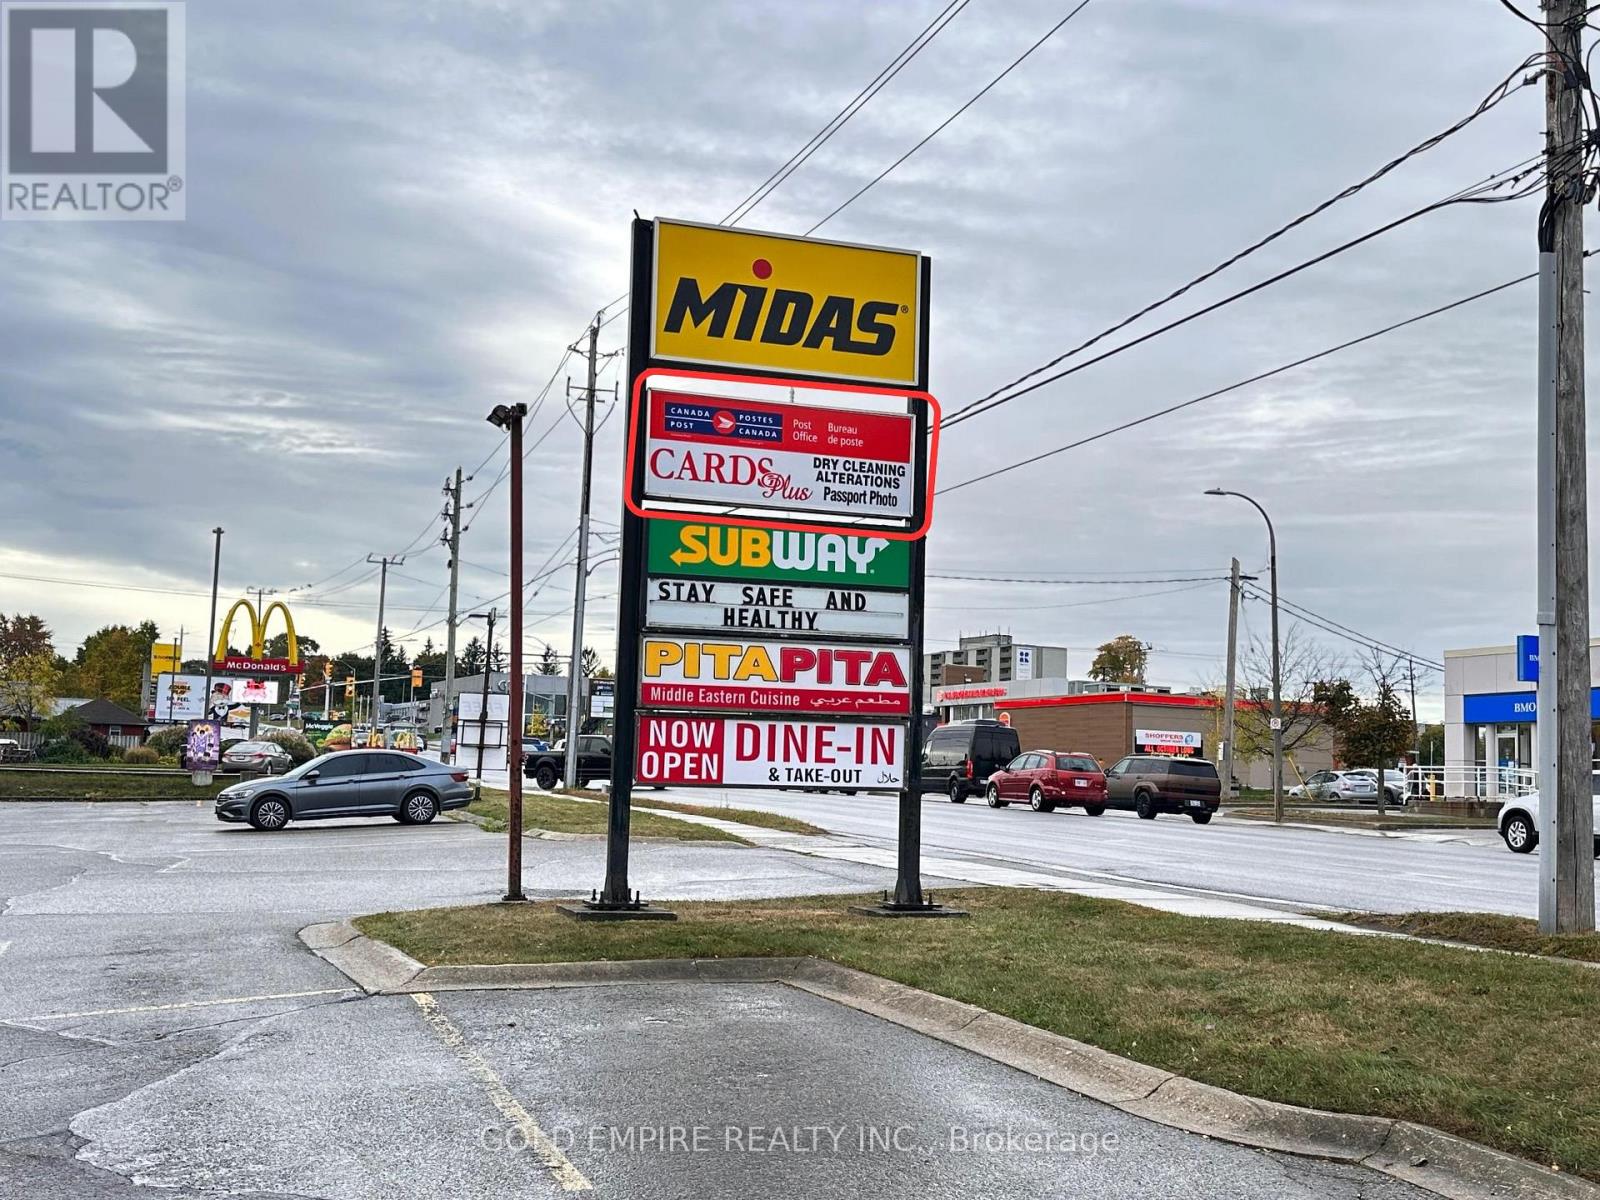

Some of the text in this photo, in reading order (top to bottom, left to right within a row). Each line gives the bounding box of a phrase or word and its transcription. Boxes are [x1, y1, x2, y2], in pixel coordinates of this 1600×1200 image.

[670, 406, 710, 419] CANADA
[739, 414, 774, 425] POSTES
[670, 420, 694, 430] POST
[793, 418, 812, 430] Post
[828, 422, 858, 435] Bureau
[739, 427, 778, 439] CANADA
[792, 430, 818, 443] Office
[827, 435, 864, 448] de poste
[650, 448, 774, 488] CARDS
[813, 456, 906, 478] DRY CLEANING
[761, 472, 813, 501] Plus
[816, 471, 900, 489] ALTERATIONS
[823, 487, 898, 507] Passport Photo
[669, 525, 890, 574] SUBWAY
[658, 581, 866, 611] STAY SAFE AND
[723, 607, 819, 630] HEALTHY
[226, 660, 287, 672] McDonald's
[650, 686, 800, 706] Middle Eastern Cuisine
[810, 694, 901, 708] مطعم عربي
[1514, 702, 1537, 713] BMO
[650, 719, 715, 748] NOW
[736, 722, 895, 766] DINE-IN
[641, 751, 719, 780] OPEN
[768, 767, 862, 784] & TAKE-OUT
